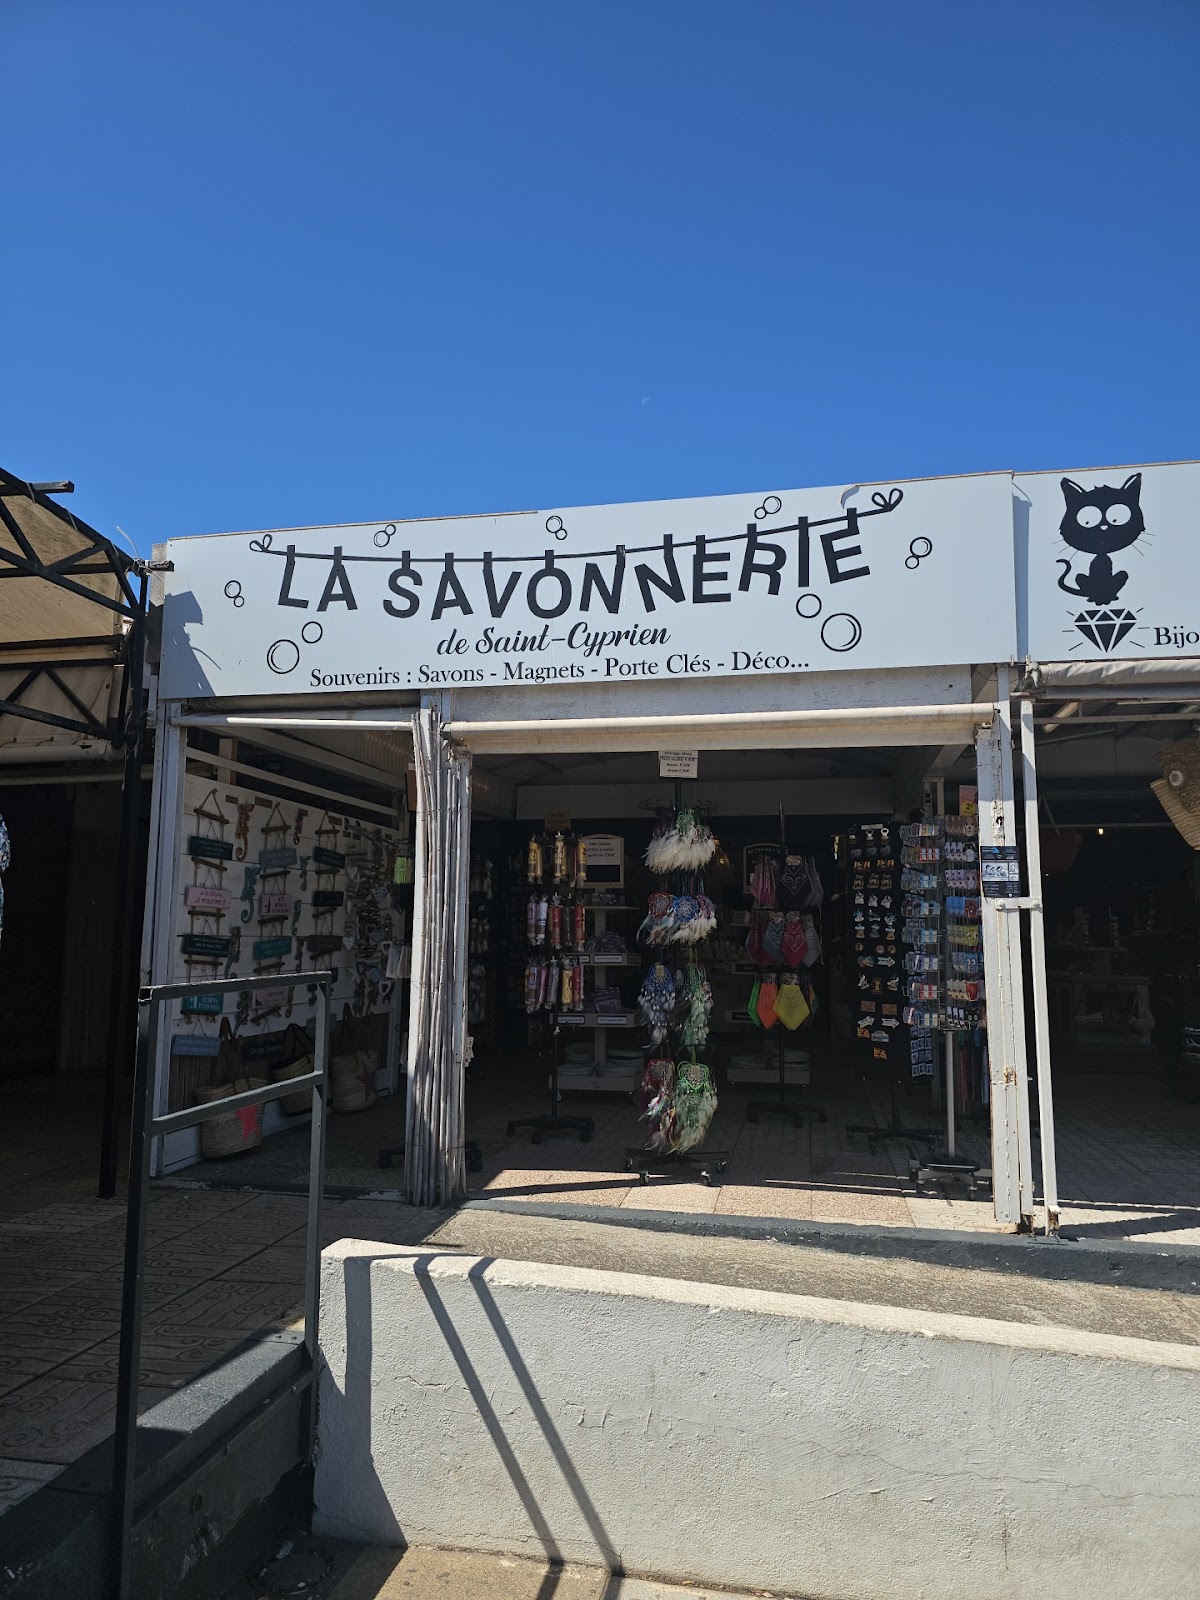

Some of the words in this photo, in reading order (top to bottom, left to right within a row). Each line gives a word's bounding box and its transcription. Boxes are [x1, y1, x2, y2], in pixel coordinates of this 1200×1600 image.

[278, 545, 358, 612] LA
[382, 508, 871, 620] SAVONNERIE
[437, 627, 470, 656] de
[476, 621, 671, 658] Saint-Cyprien
[311, 666, 400, 688] Souvenirs
[419, 665, 484, 683] Savons
[503, 661, 584, 684] Magnets
[605, 658, 658, 678] Porte
[666, 653, 711, 674] Clés
[731, 651, 809, 671] Déco...
